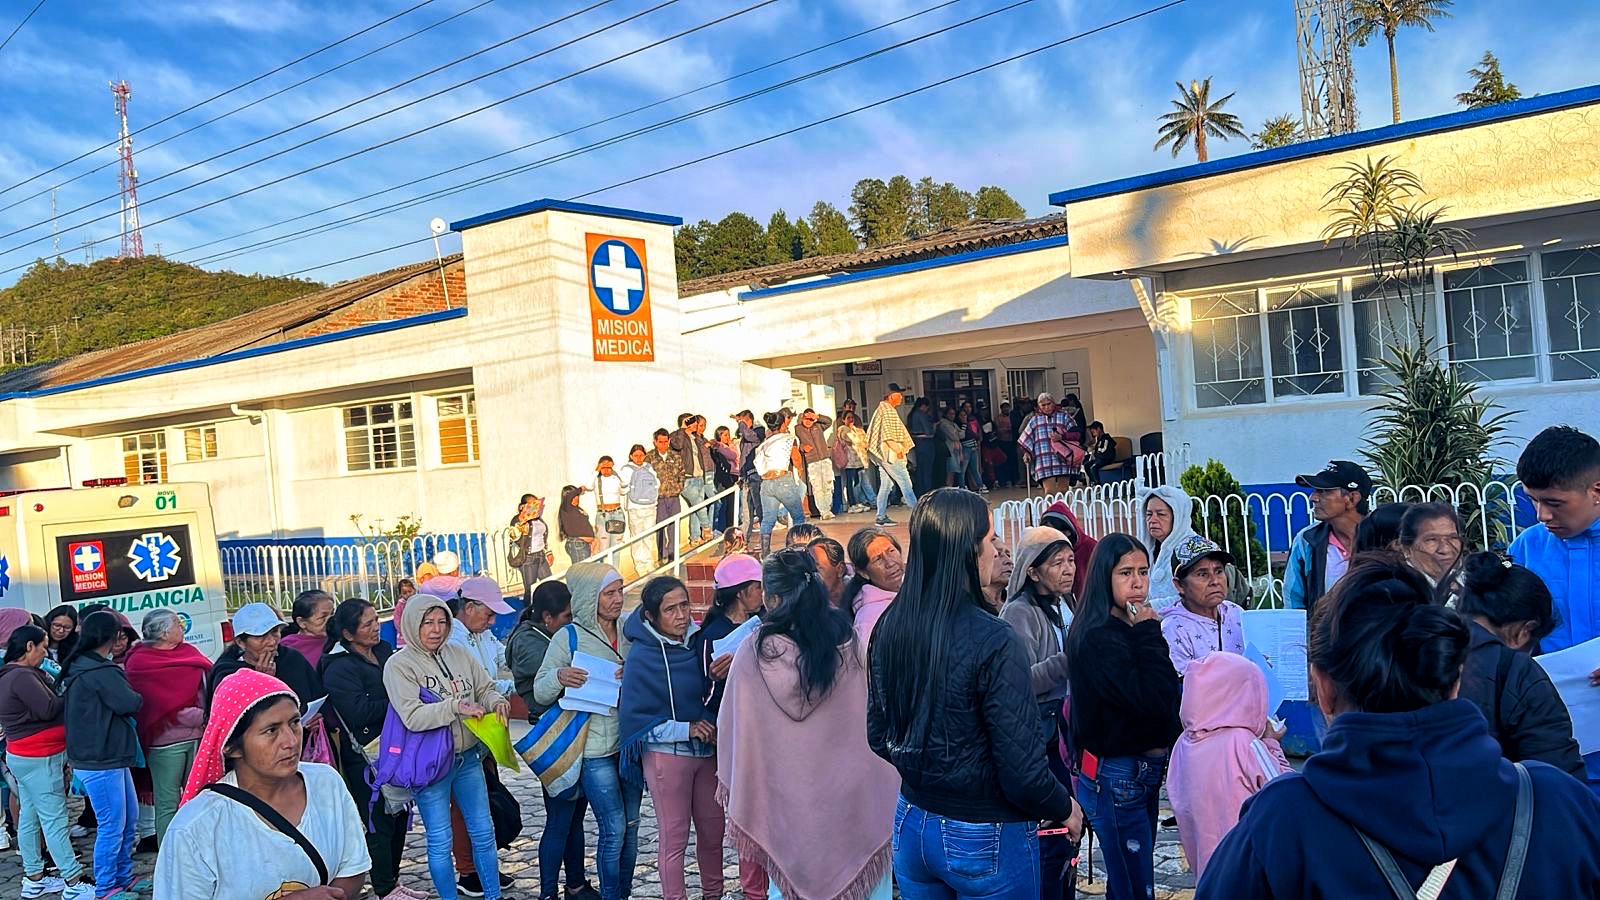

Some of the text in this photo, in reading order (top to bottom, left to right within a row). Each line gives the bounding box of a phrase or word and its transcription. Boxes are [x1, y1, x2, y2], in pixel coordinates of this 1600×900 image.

[597, 319, 648, 336] MISION
[595, 338, 652, 356] MEDICA
[155, 494, 177, 510] 01
[75, 572, 104, 583] MISION
[75, 580, 106, 590] MEDICA
